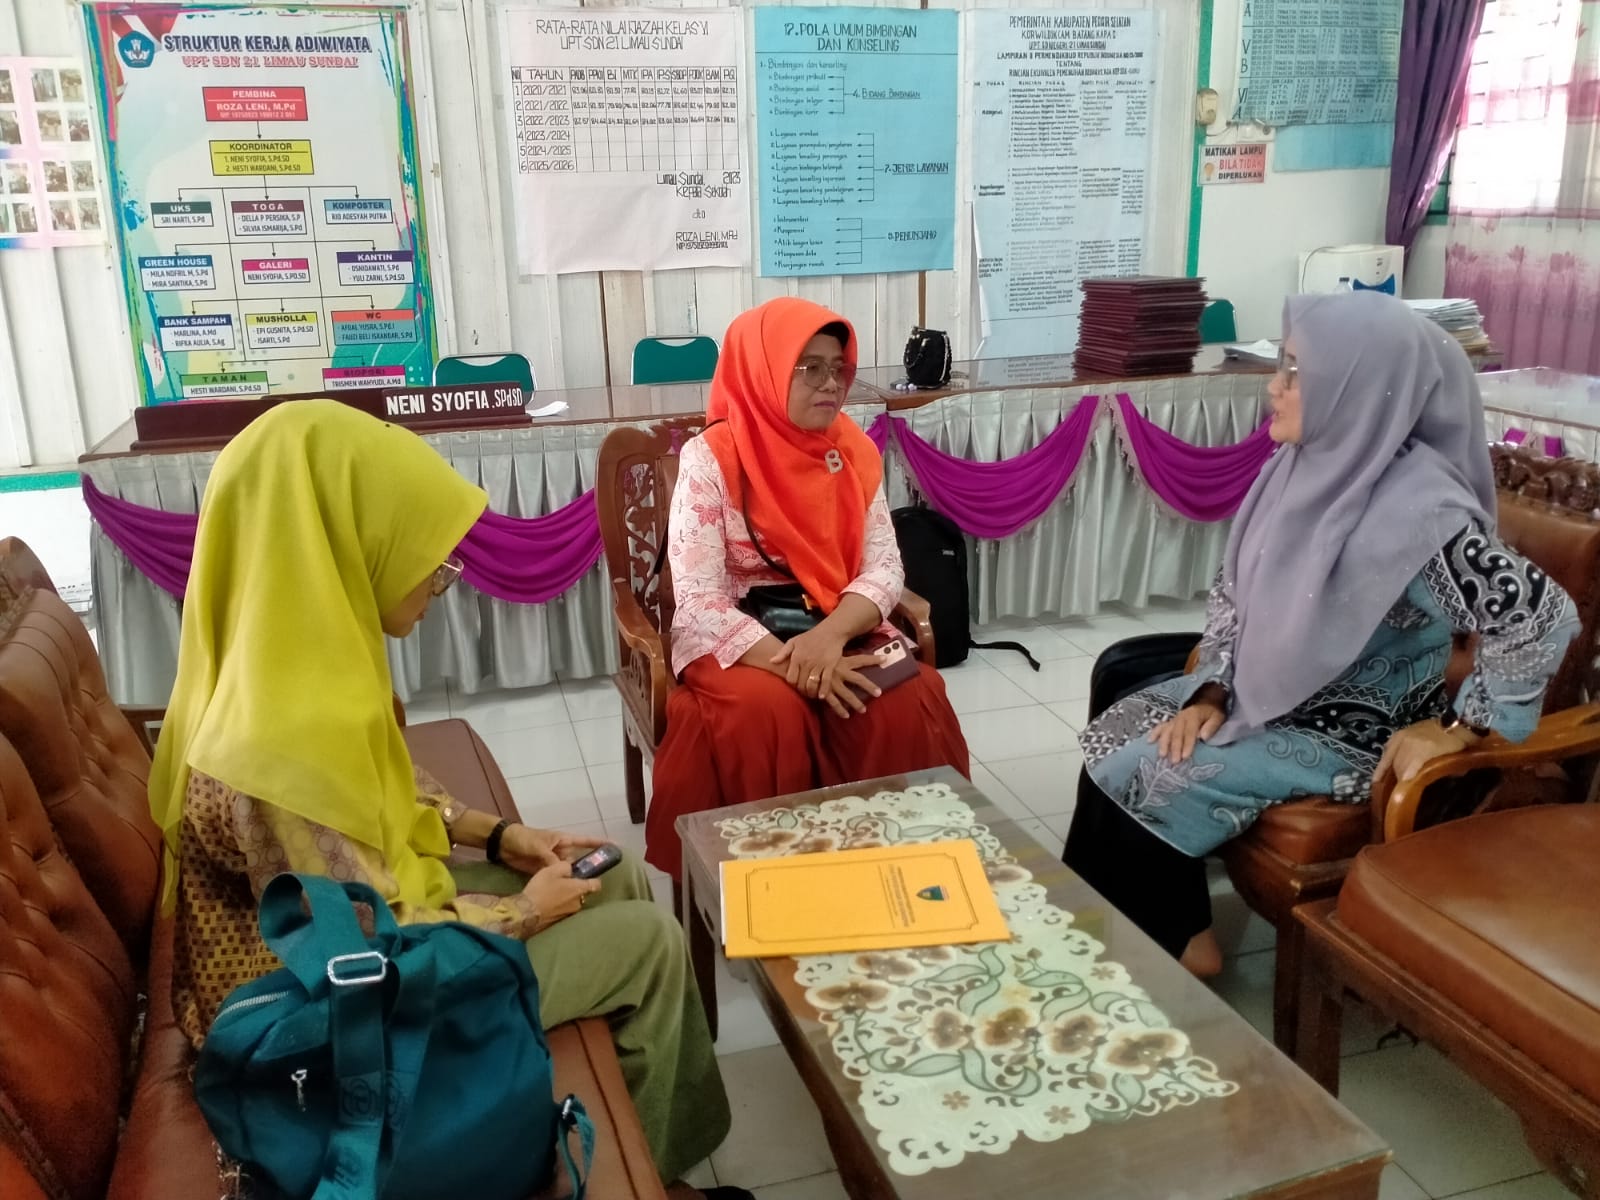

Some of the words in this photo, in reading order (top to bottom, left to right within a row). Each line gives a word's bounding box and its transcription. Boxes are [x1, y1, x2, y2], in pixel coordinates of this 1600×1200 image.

[536, 19, 600, 34] RATA-RATA
[667, 20, 698, 35] KELAS
[1009, 16, 1051, 28] PEMERINTAH
[1053, 16, 1091, 28] KABUPATEN
[834, 24, 864, 37] UMUM
[866, 24, 917, 38] BIMBINGAN
[1072, 30, 1095, 40] BATANG
[163, 35, 241, 52] STRUKTUR
[245, 35, 291, 52] KERJA
[295, 36, 372, 53] ADIWIYATA
[560, 36, 583, 50] UPT
[818, 38, 841, 51] DAN
[847, 39, 900, 52] KONSELING
[182, 55, 210, 68] UPT
[212, 55, 240, 68] SDN
[243, 56, 260, 68] 21
[263, 56, 306, 68] LIMAU
[308, 56, 359, 68] SUNDAI
[527, 69, 564, 80] TAHUN
[232, 90, 277, 98] PEMBINA
[216, 103, 243, 111] ROZA
[273, 103, 296, 111] M.Pd
[527, 130, 570, 141] 2023/2024
[229, 143, 293, 151] KOORDINATOR
[527, 145, 571, 156] 2024/2025
[1205, 147, 1237, 156] MATIKAN
[1240, 147, 1263, 155] LAMPU
[529, 160, 574, 171] 2025/2026
[916, 162, 949, 174] LAYANAN
[1219, 159, 1237, 170] BILA
[1218, 172, 1263, 180] DIPERLUKAN
[170, 205, 191, 213] UKS
[252, 203, 285, 211] TOGA
[144, 259, 175, 267] GREEN
[177, 258, 207, 266] HOUSE
[259, 261, 292, 269] GALERI
[164, 318, 189, 326] BANK
[256, 315, 307, 323] MUSHOLLA
[202, 374, 247, 383] TAMAN
[385, 394, 426, 416] NENI
[431, 390, 490, 412] SYOFIA
